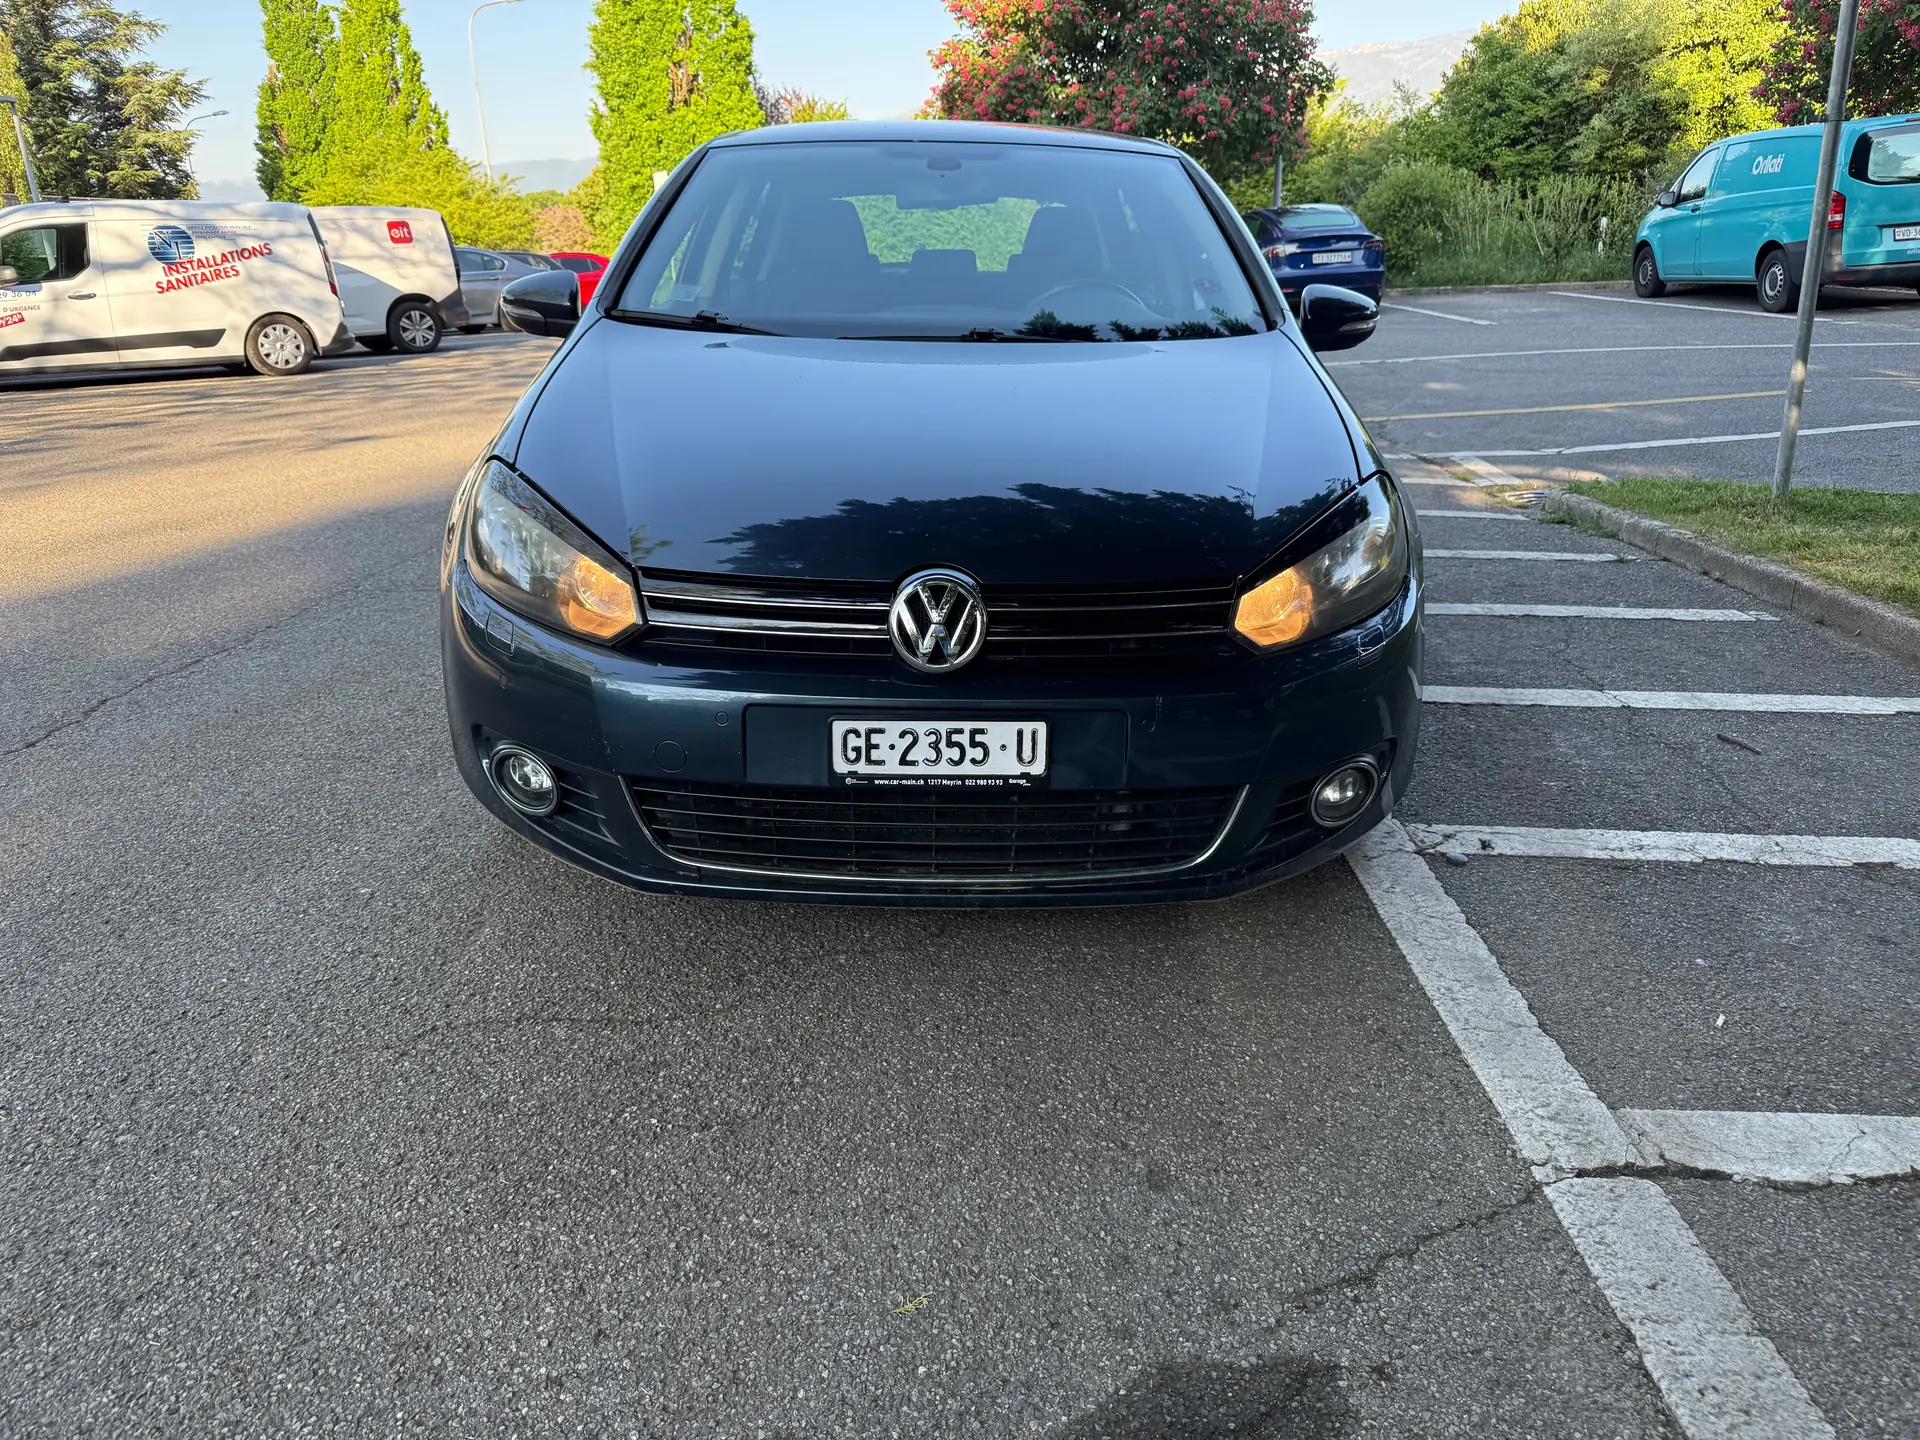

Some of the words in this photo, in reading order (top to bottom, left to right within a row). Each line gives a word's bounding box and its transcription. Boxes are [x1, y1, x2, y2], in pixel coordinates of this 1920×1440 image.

[391, 226, 410, 238] eit
[162, 242, 273, 278] INSTALLATIONS
[155, 265, 241, 294] SANITAIRES
[874, 778, 925, 786] www.car-main.ch
[927, 778, 941, 786] 1217
[942, 778, 962, 787] Meyrin
[965, 778, 976, 786] 022
